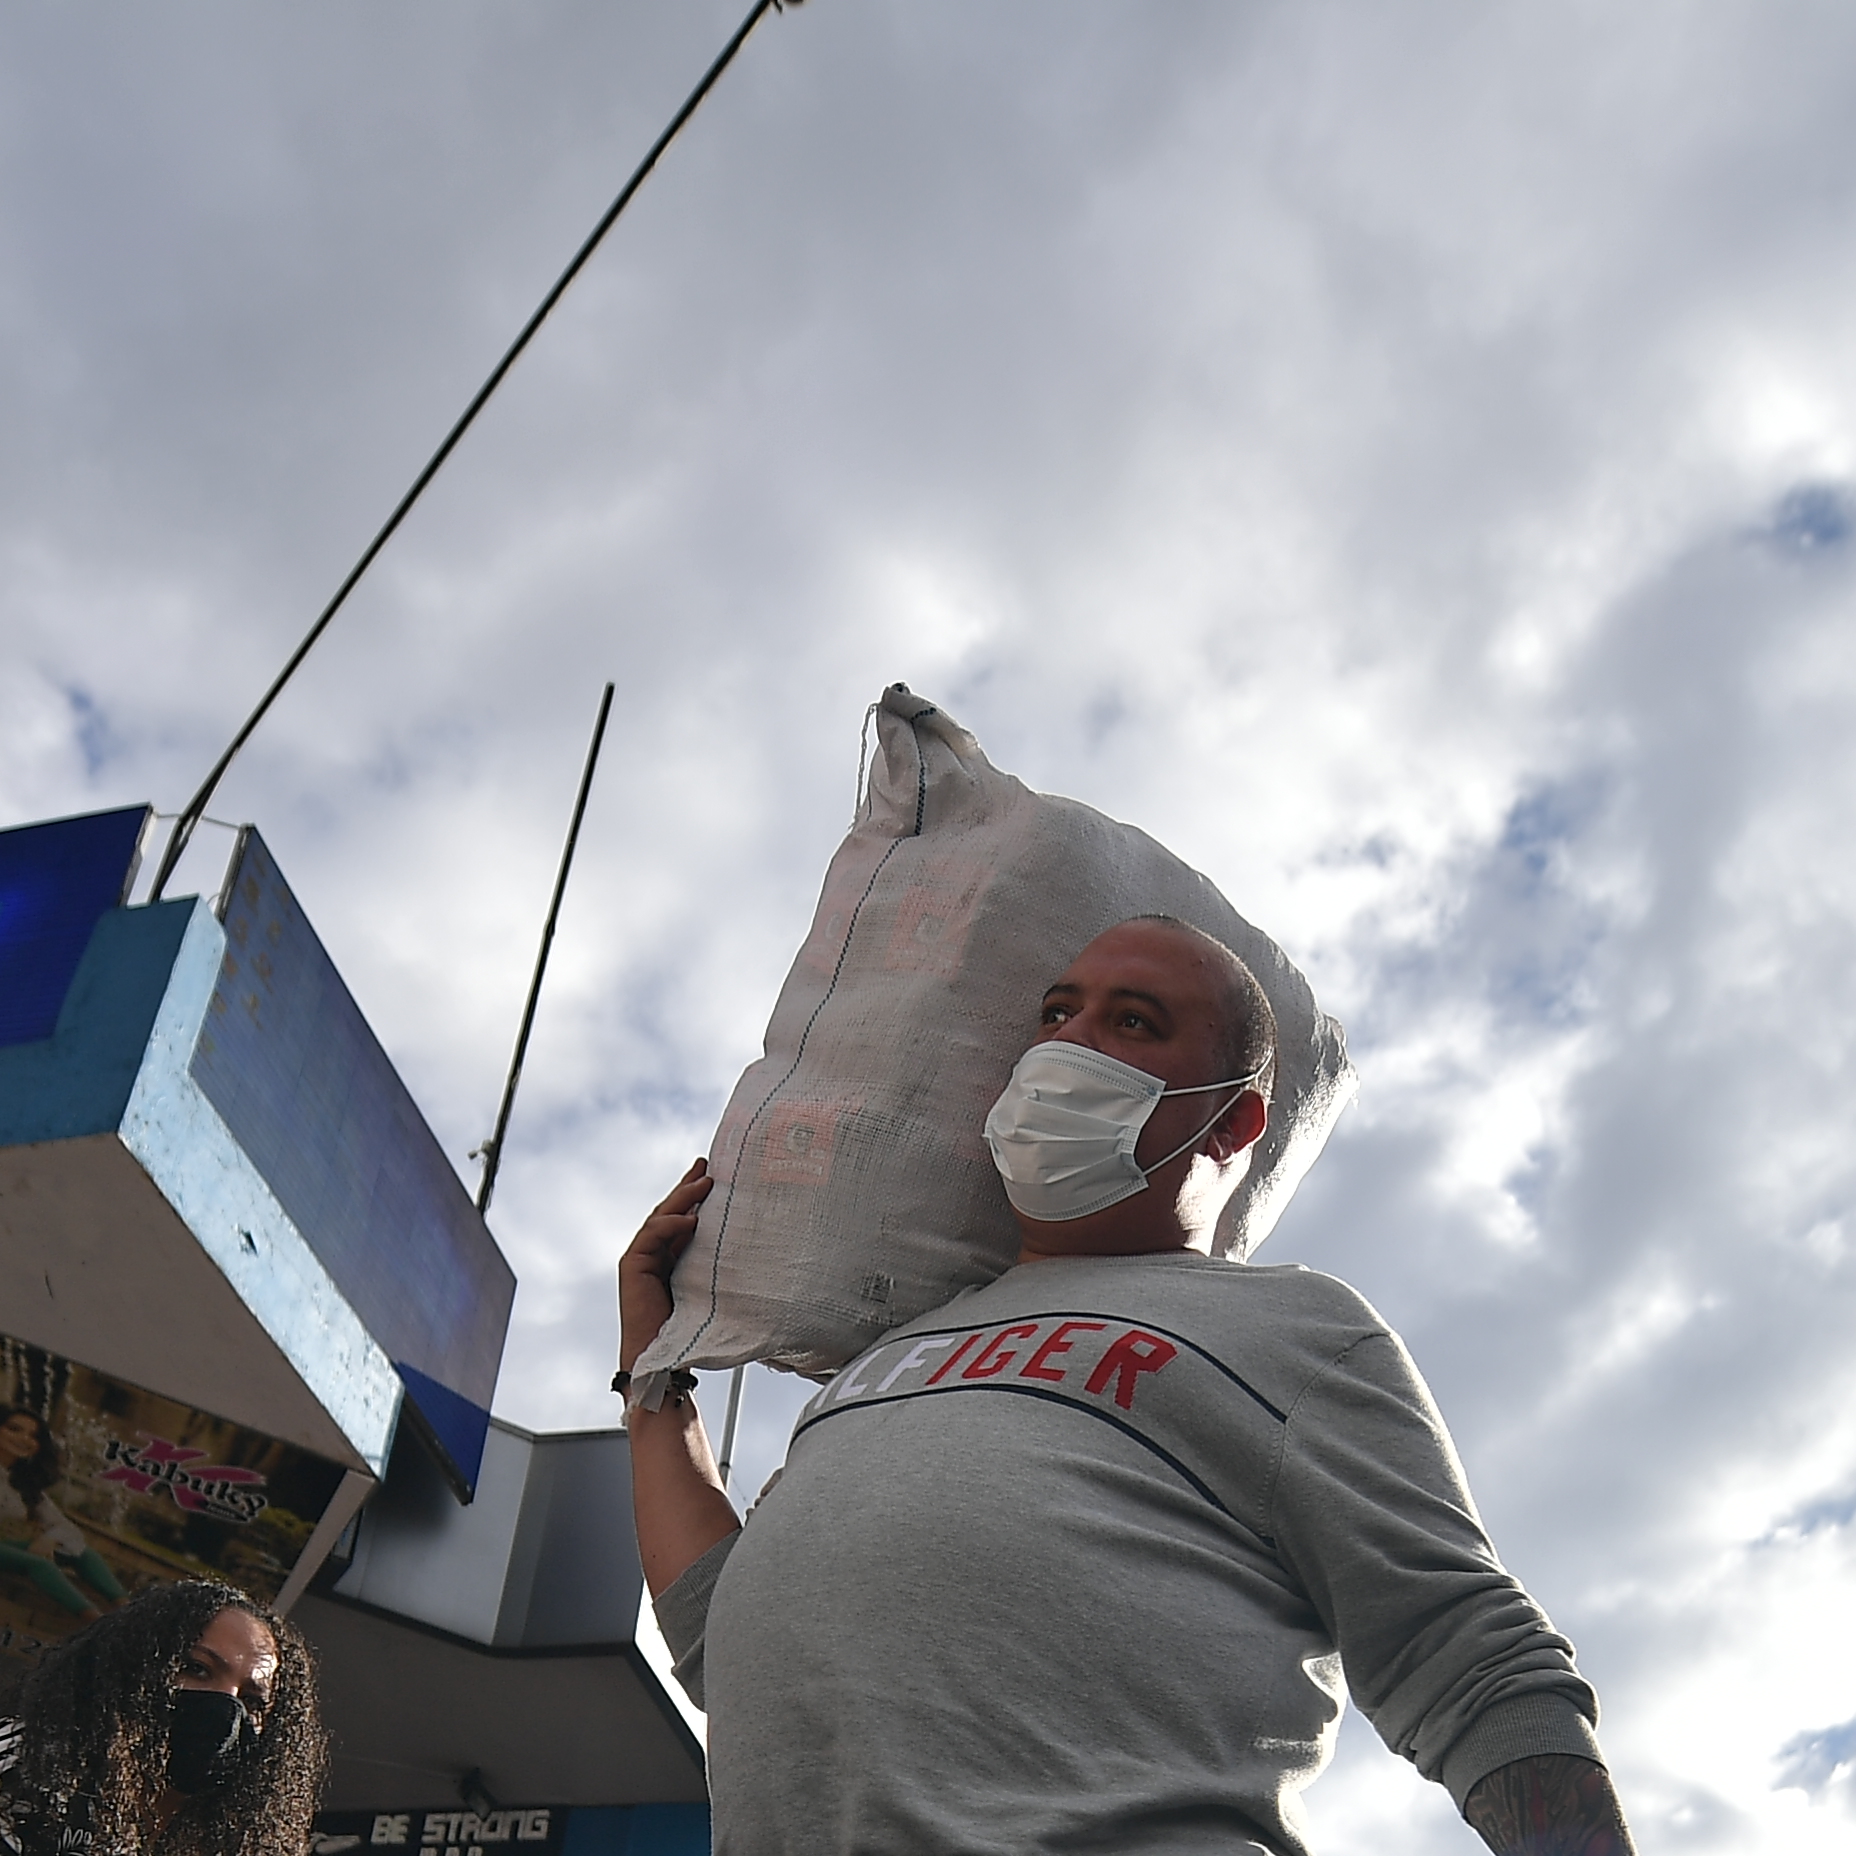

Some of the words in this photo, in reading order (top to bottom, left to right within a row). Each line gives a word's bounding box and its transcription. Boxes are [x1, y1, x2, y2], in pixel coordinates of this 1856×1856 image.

[105, 1441, 266, 1518] Kabuky
[371, 1813, 410, 1845] BE
[421, 1809, 550, 1844] STRONG
